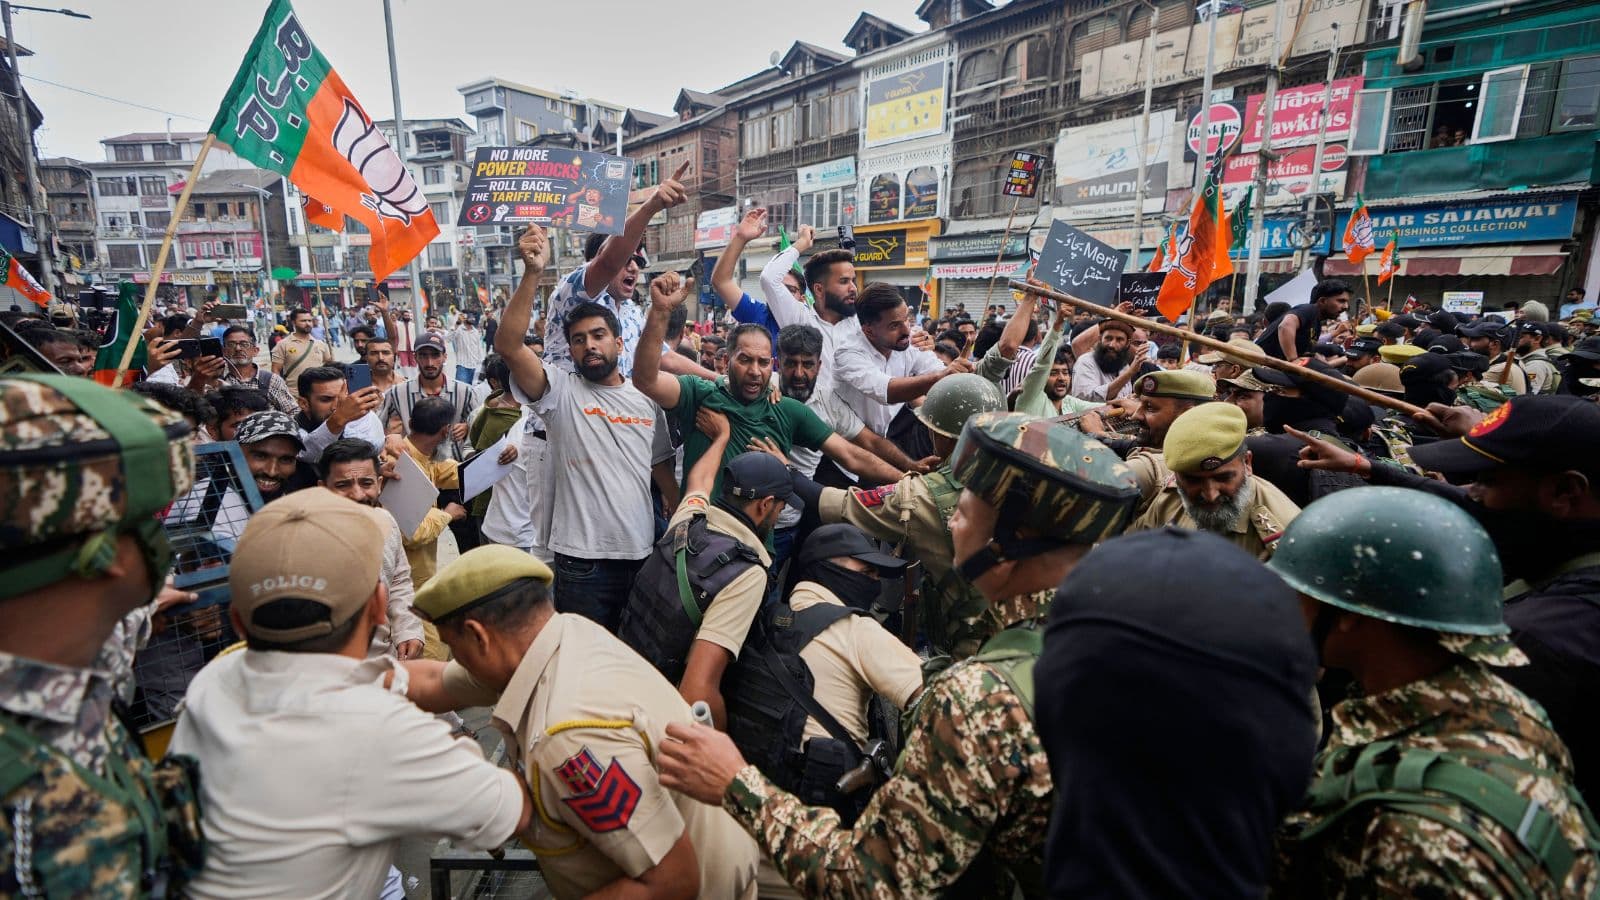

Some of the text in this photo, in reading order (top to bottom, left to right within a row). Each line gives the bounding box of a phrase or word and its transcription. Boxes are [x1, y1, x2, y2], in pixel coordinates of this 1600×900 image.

[1189, 123, 1240, 140] Hwkns
[490, 149, 549, 162] NO MORE
[1250, 162, 1309, 180] Hwkins
[489, 180, 552, 192] ROLL BACK
[471, 191, 566, 205] THE TARIFF HIKE!
[1424, 203, 1563, 225] SAJAWAT
[1450, 220, 1527, 234] COLLECTION
[1083, 241, 1119, 272] Merit
[249, 575, 328, 596] POLICE
